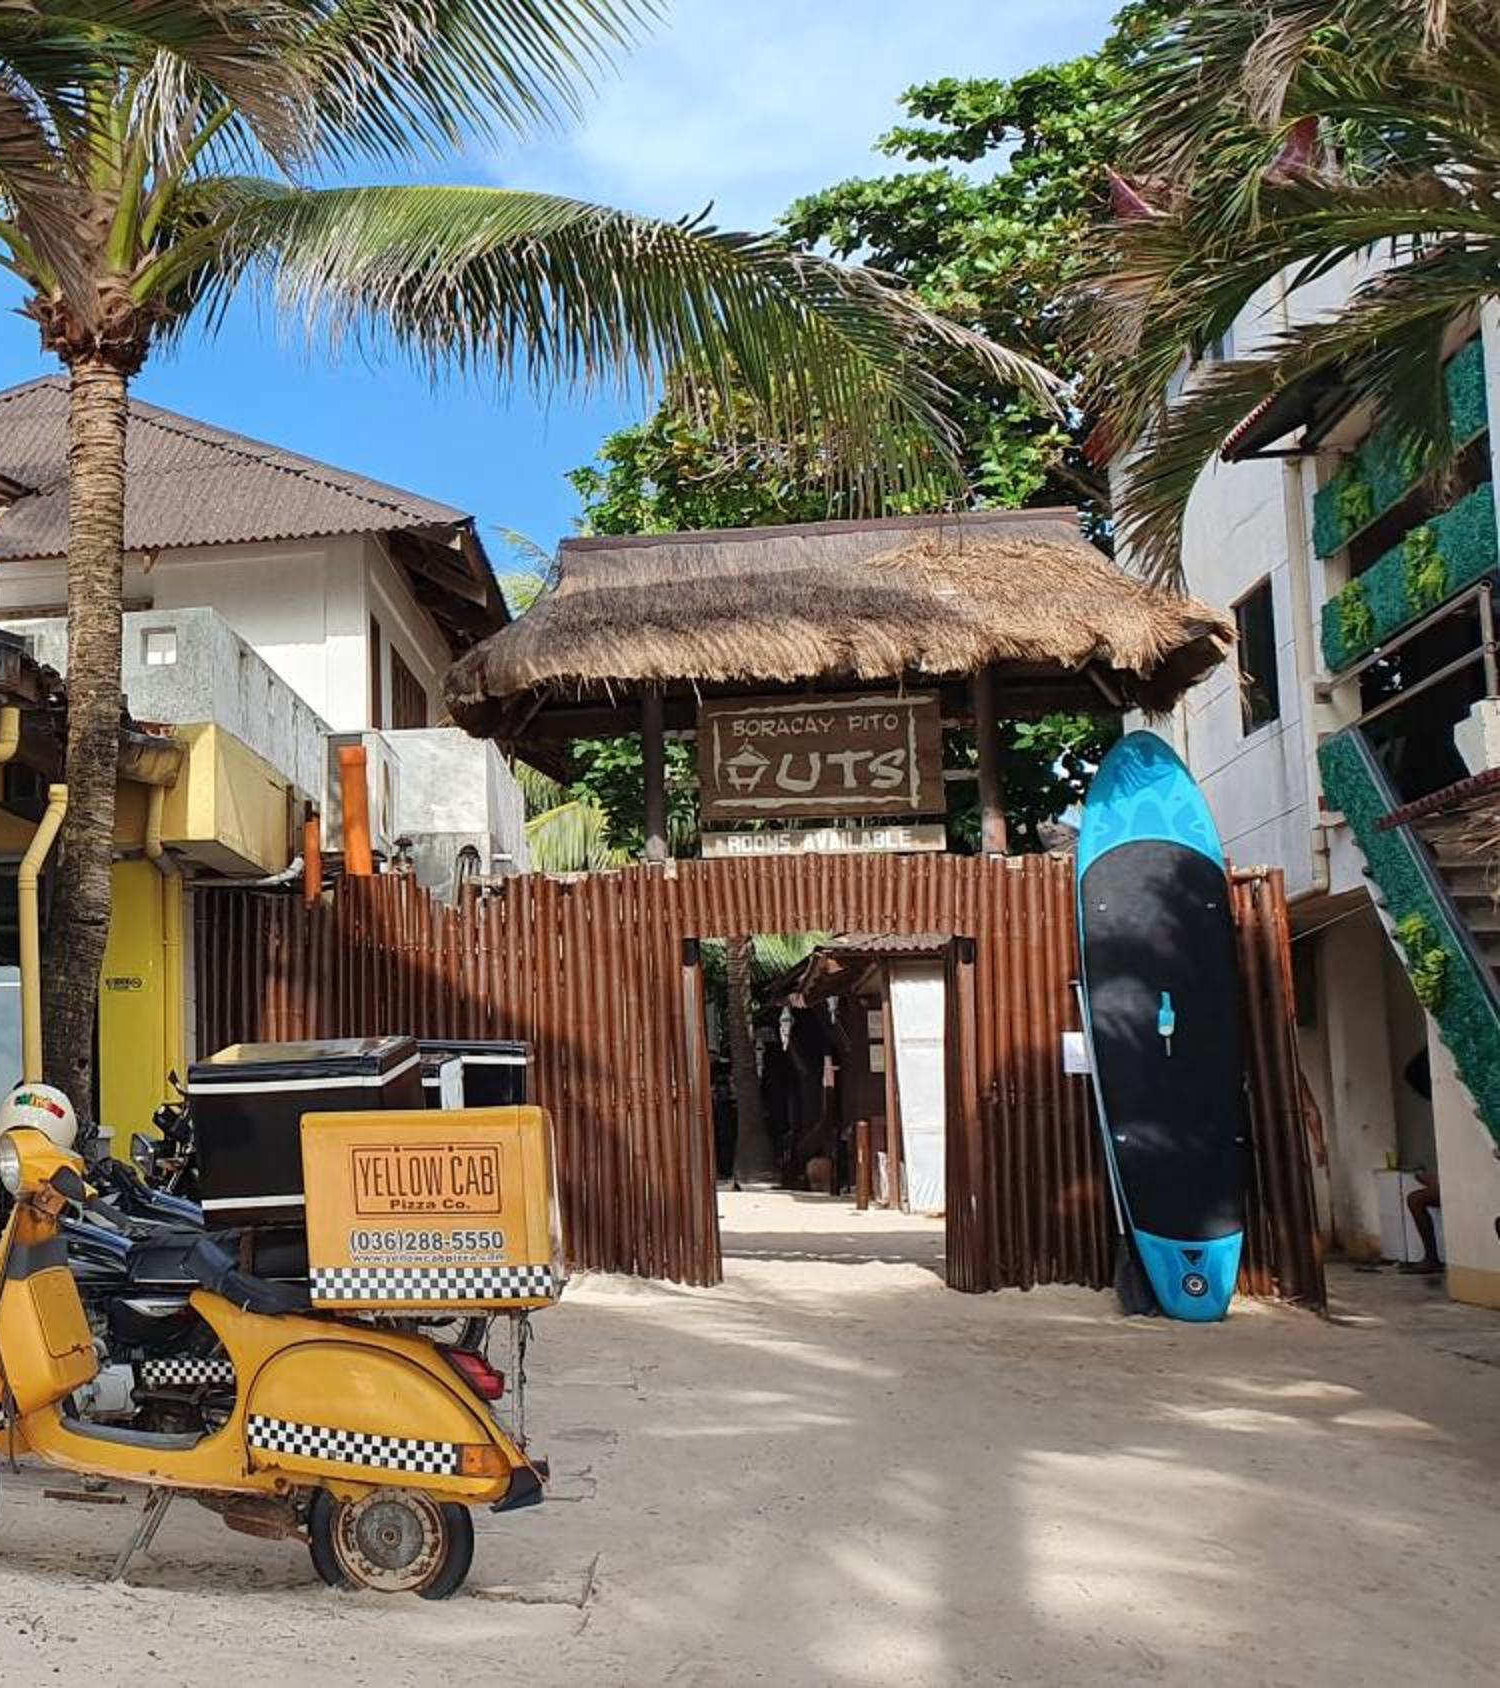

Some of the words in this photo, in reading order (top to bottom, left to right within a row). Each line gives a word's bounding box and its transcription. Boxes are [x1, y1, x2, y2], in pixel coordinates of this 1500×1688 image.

[732, 716, 835, 737] BORACAY
[846, 713, 900, 732] PITO
[727, 833, 791, 854] ROOMS
[803, 829, 912, 852] AVAILABLE
[358, 1156, 443, 1197] YELLOW
[450, 1155, 494, 1197] CAB
[390, 1199, 436, 1210] Pizza
[443, 1199, 471, 1210] Co.
[351, 1230, 504, 1251] (036)288-5550
